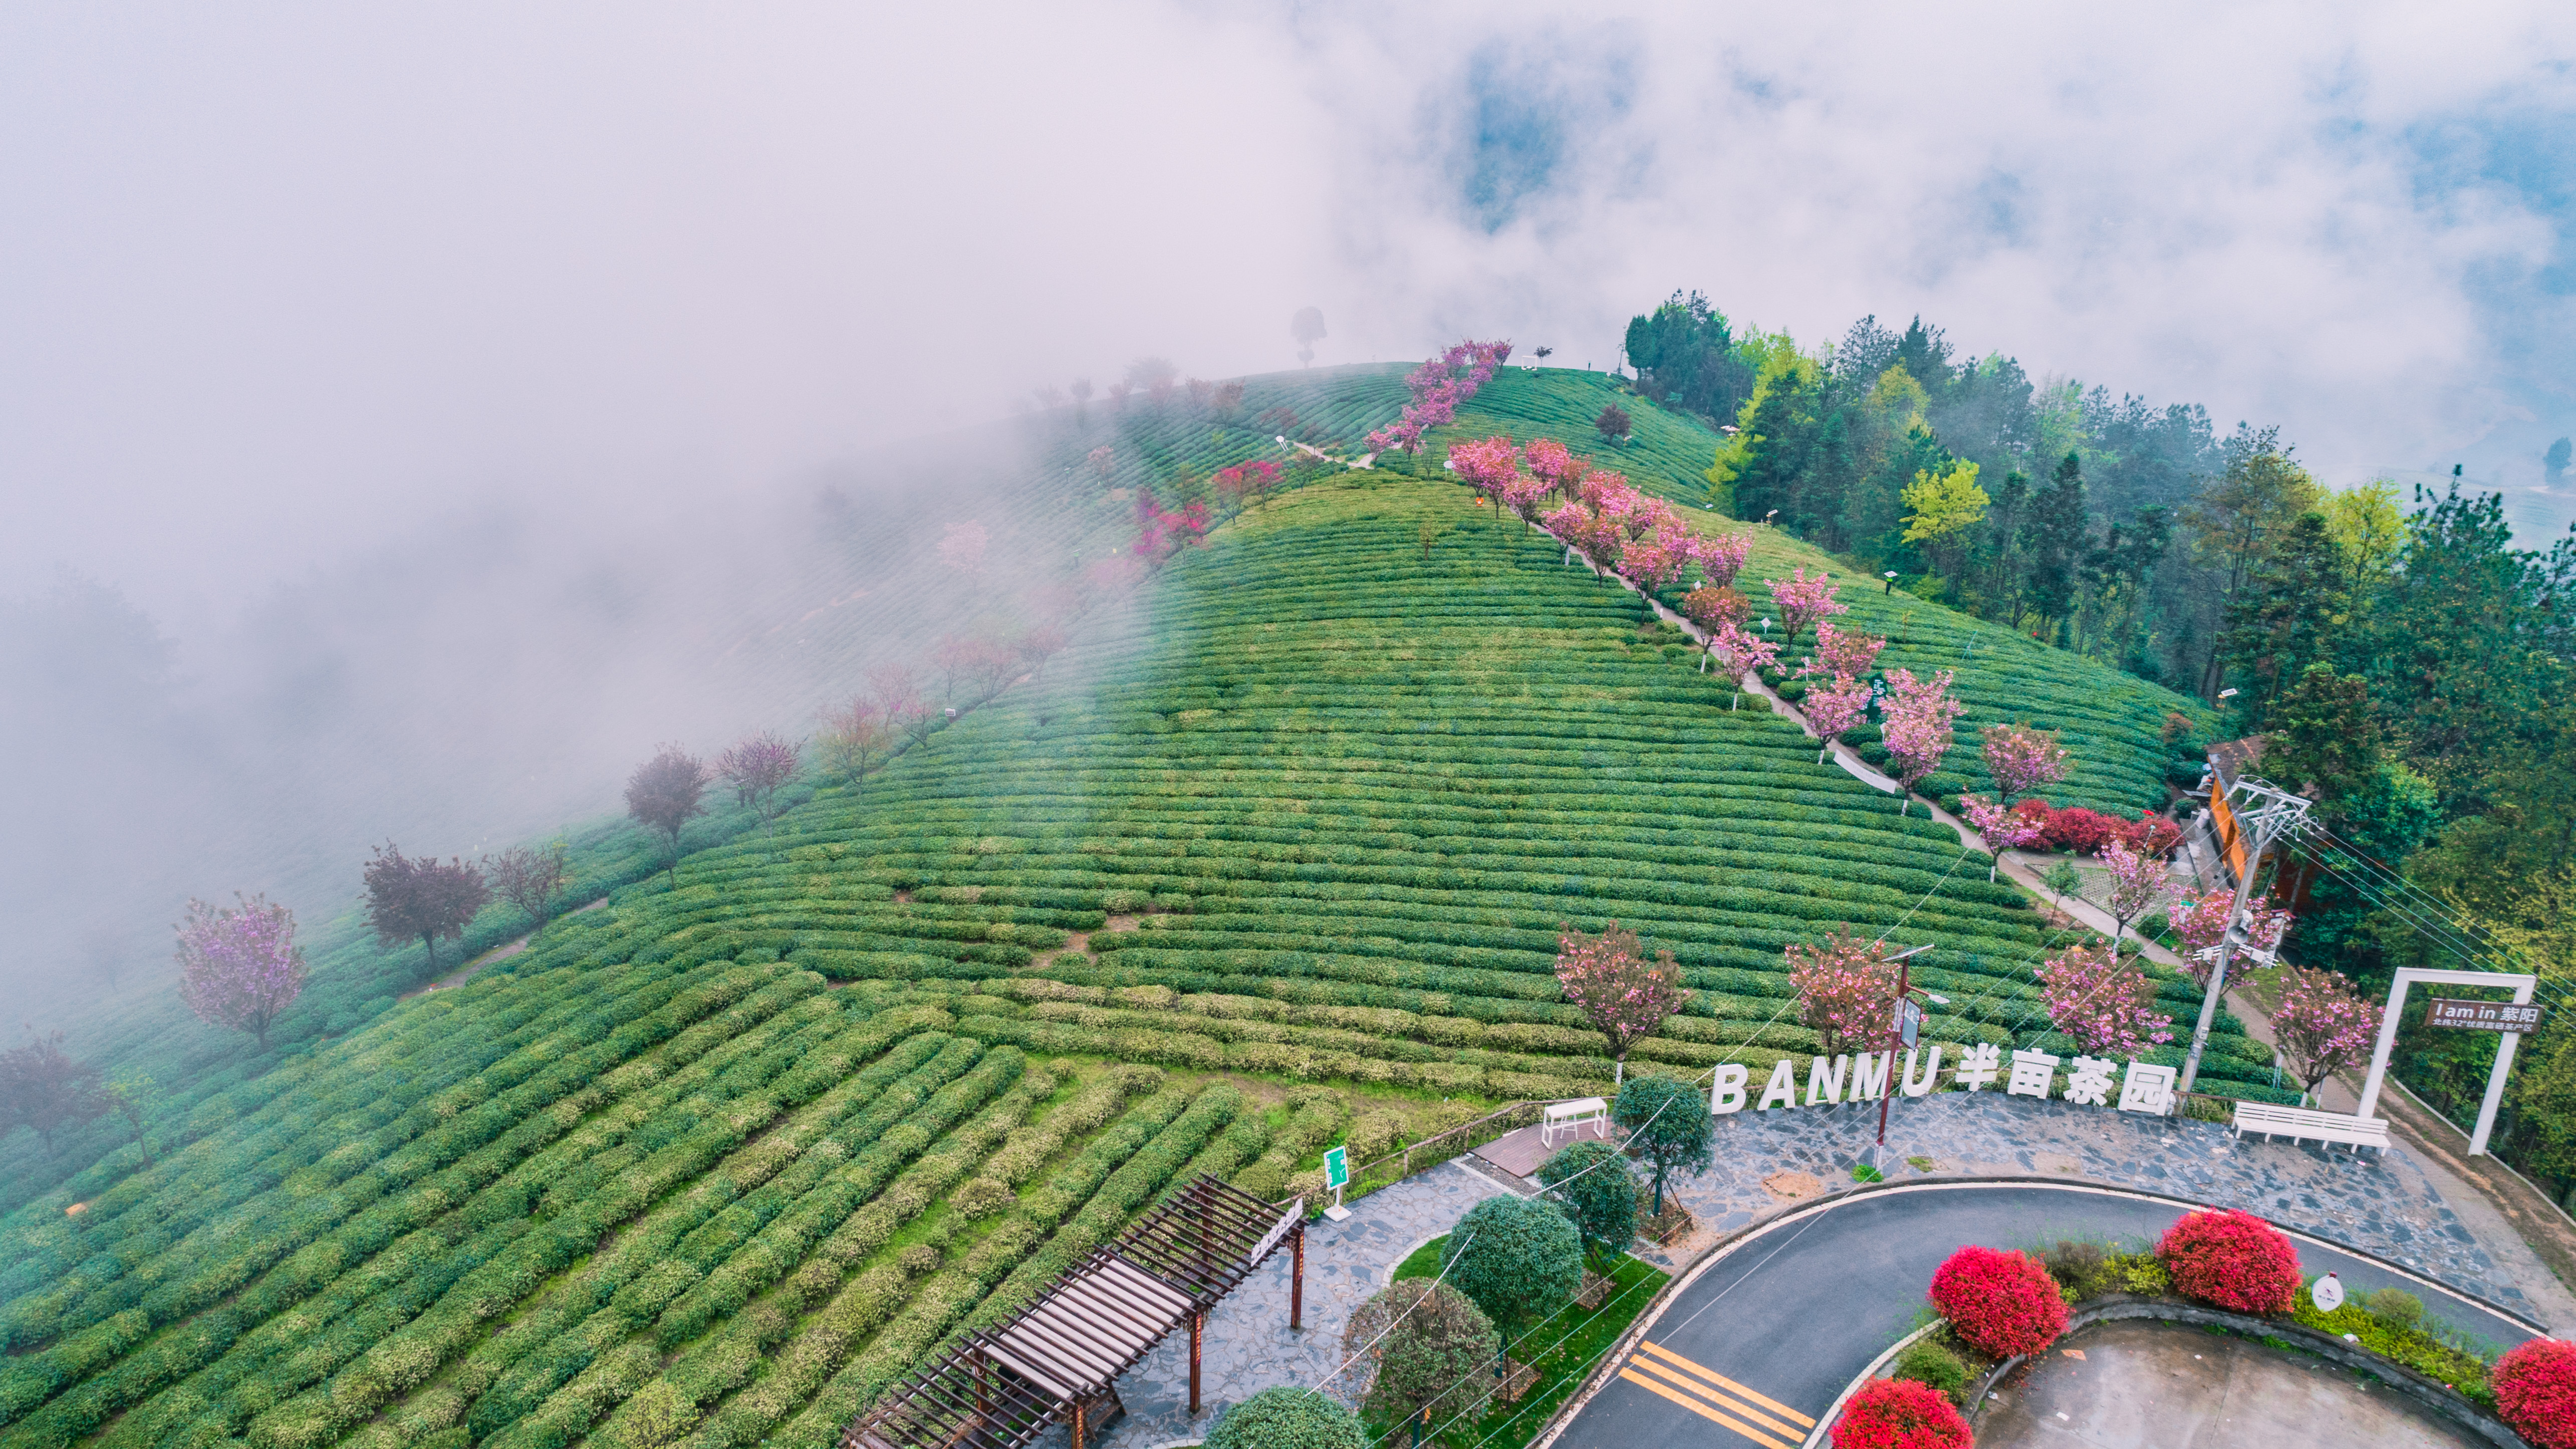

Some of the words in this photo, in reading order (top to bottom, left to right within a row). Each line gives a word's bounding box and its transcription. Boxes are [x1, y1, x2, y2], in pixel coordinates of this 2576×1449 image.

[2436, 1003, 2443, 1016] I
[2445, 1007, 2474, 1018] am
[2478, 1006, 2496, 1019] in
[2500, 1006, 2539, 1023] 紫阳
[1711, 1046, 1942, 1115] BANMU
[1955, 1043, 2177, 1116] 半亩茶园
